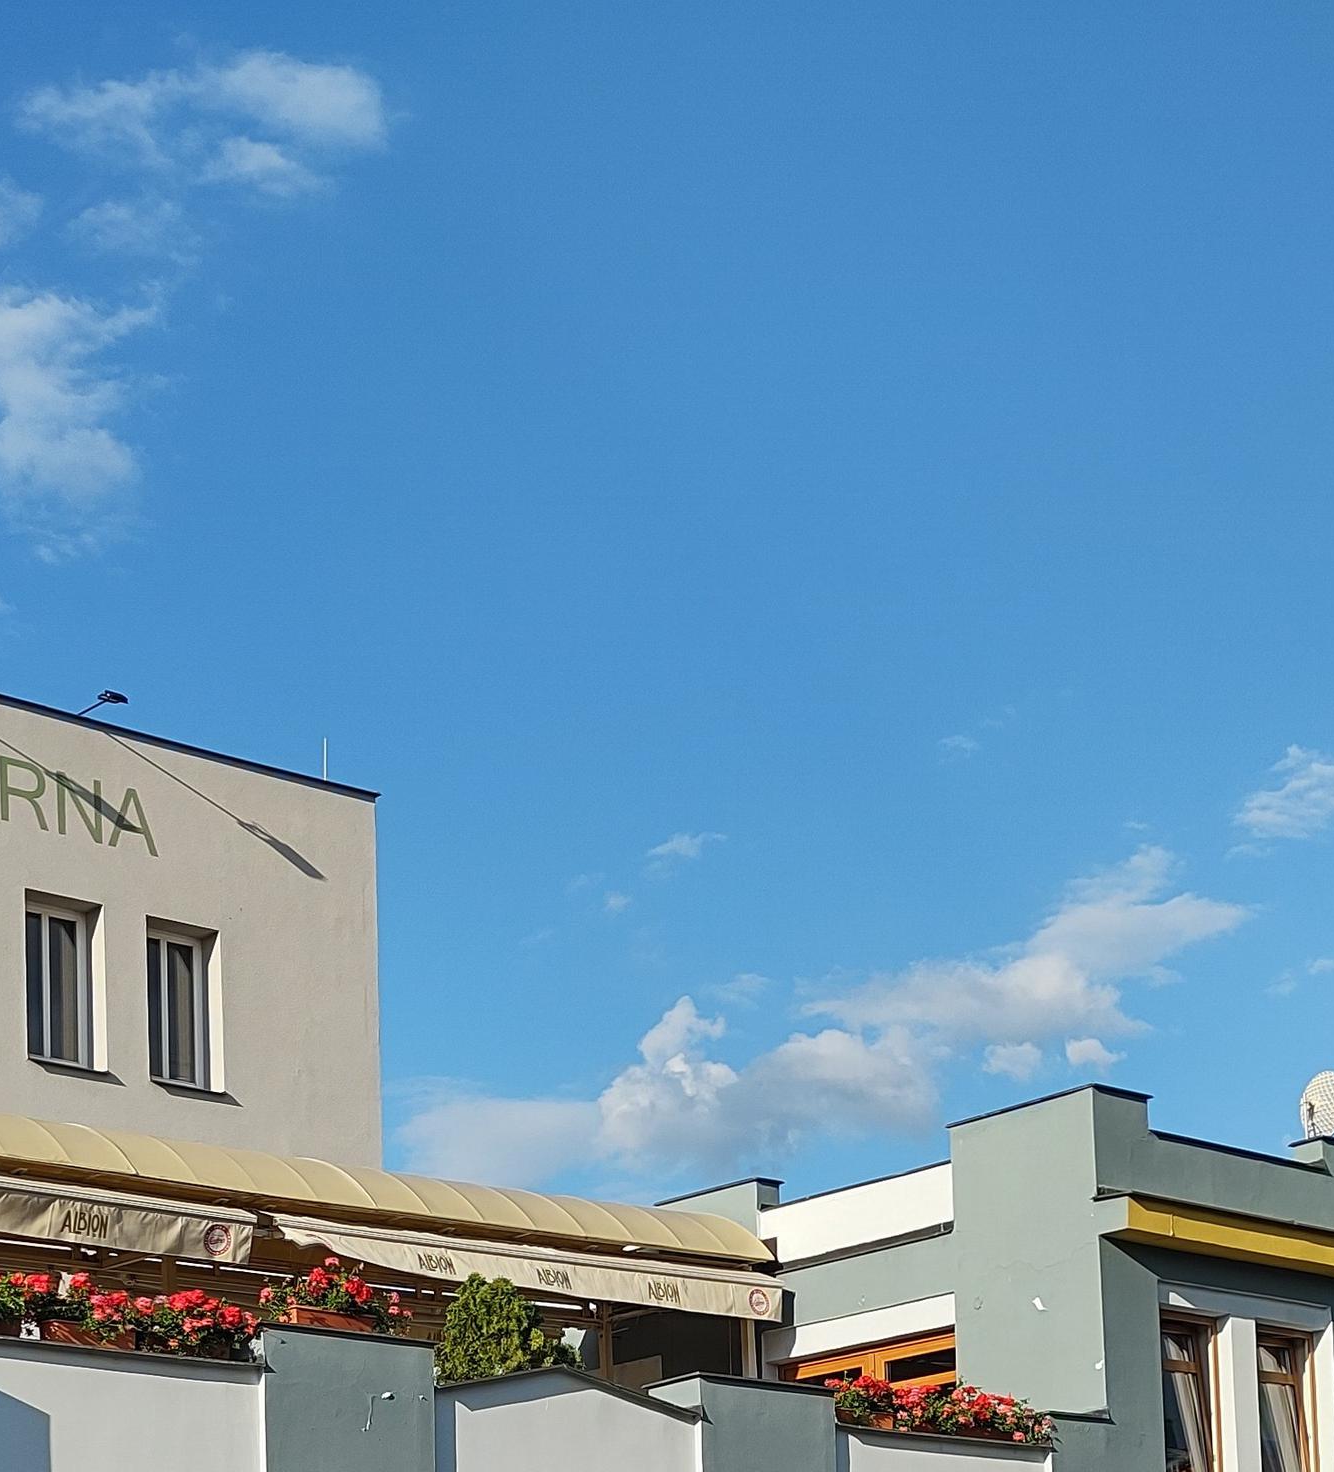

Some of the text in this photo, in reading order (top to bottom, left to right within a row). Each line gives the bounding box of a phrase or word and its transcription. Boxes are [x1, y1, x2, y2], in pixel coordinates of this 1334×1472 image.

[60, 1210, 109, 1239] ALBION
[417, 1253, 457, 1276] ALBION
[536, 1267, 573, 1290] ALBION
[647, 1280, 681, 1304] ALBION
